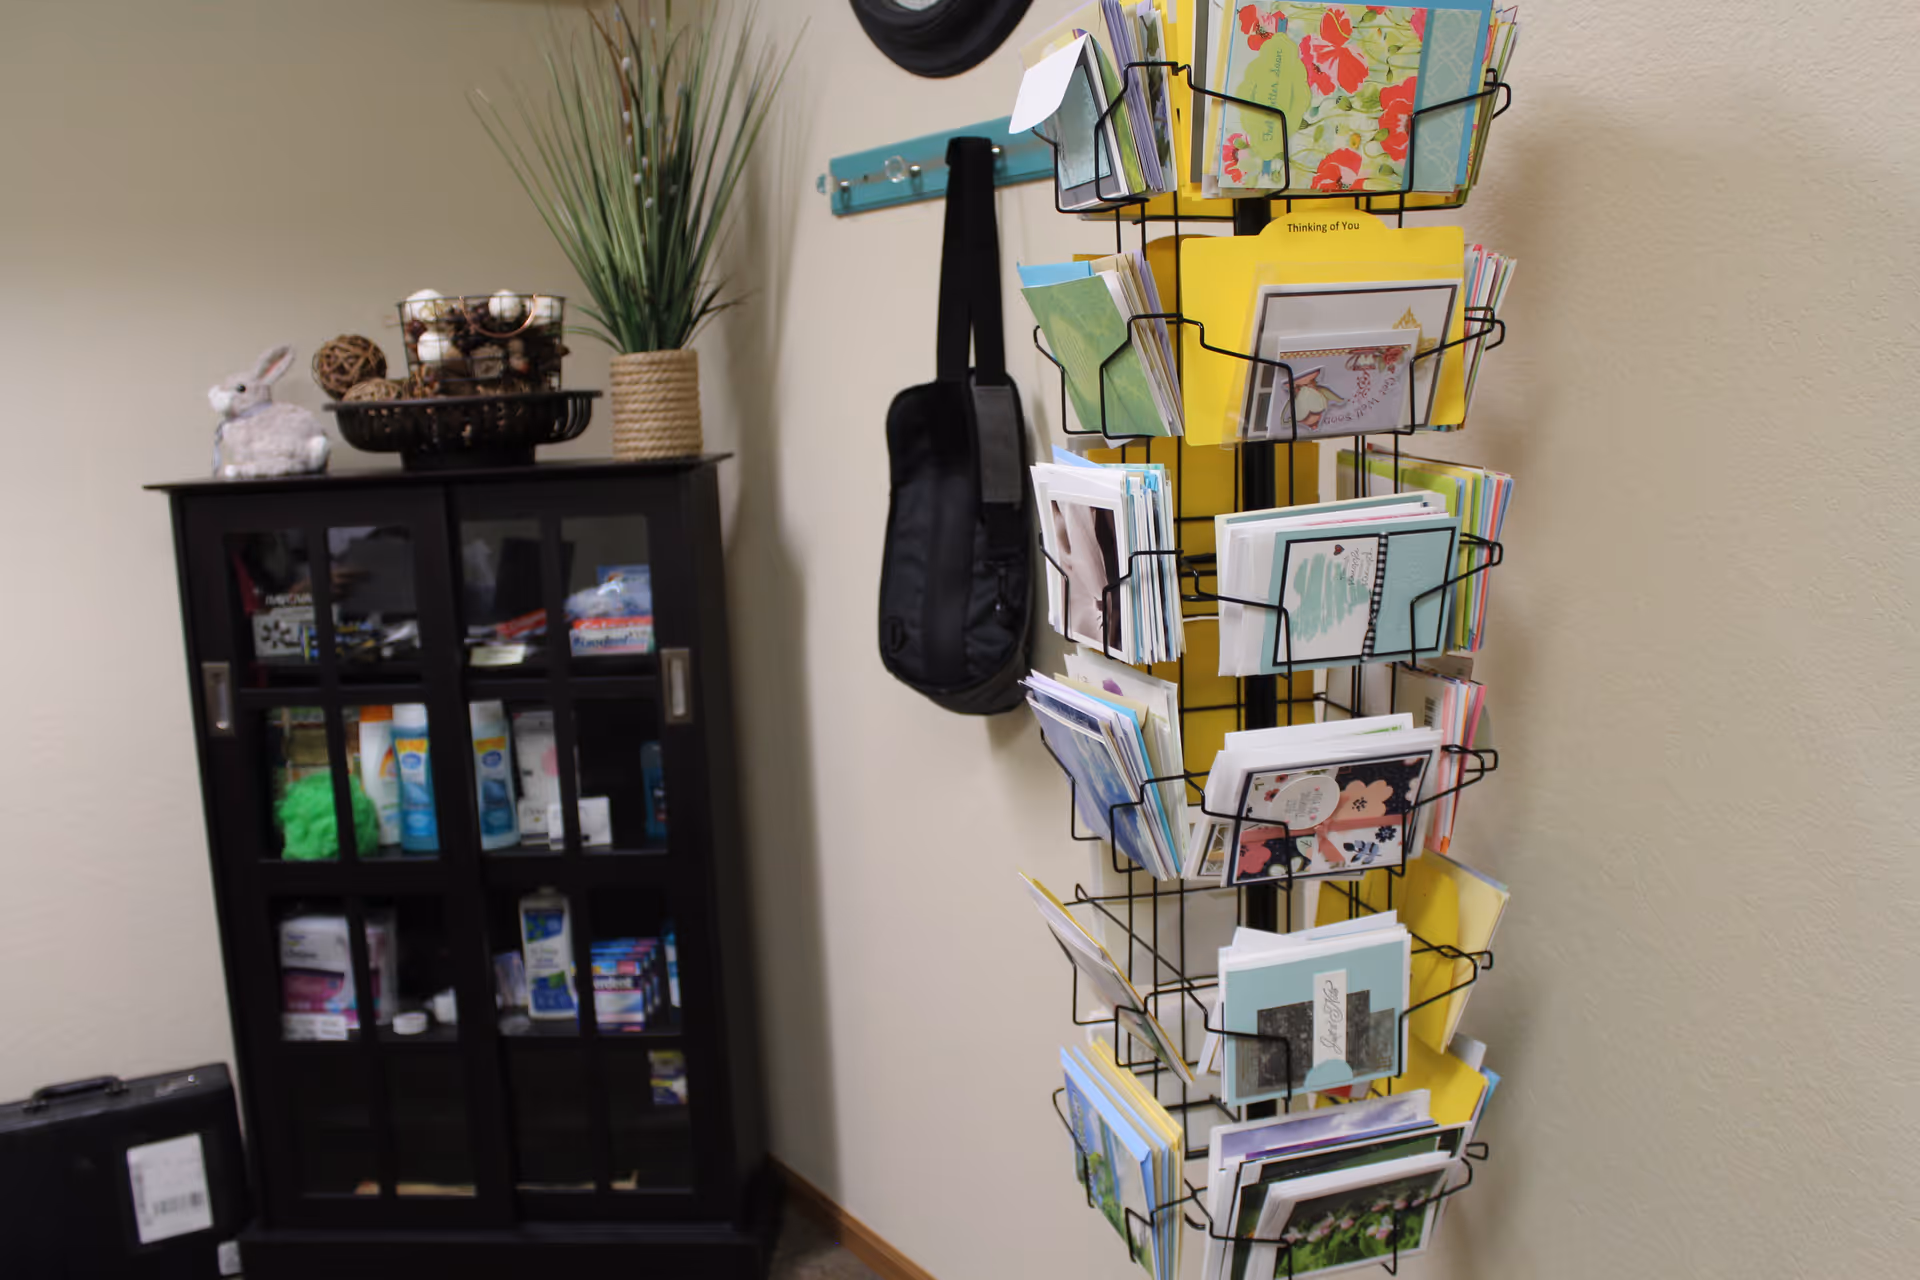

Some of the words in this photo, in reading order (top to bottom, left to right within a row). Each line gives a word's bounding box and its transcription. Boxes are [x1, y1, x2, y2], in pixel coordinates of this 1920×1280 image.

[1287, 222, 1328, 233] Thinking
[1329, 220, 1340, 231] of
[1341, 221, 1360, 231] You
[1355, 397, 1380, 419] Well
